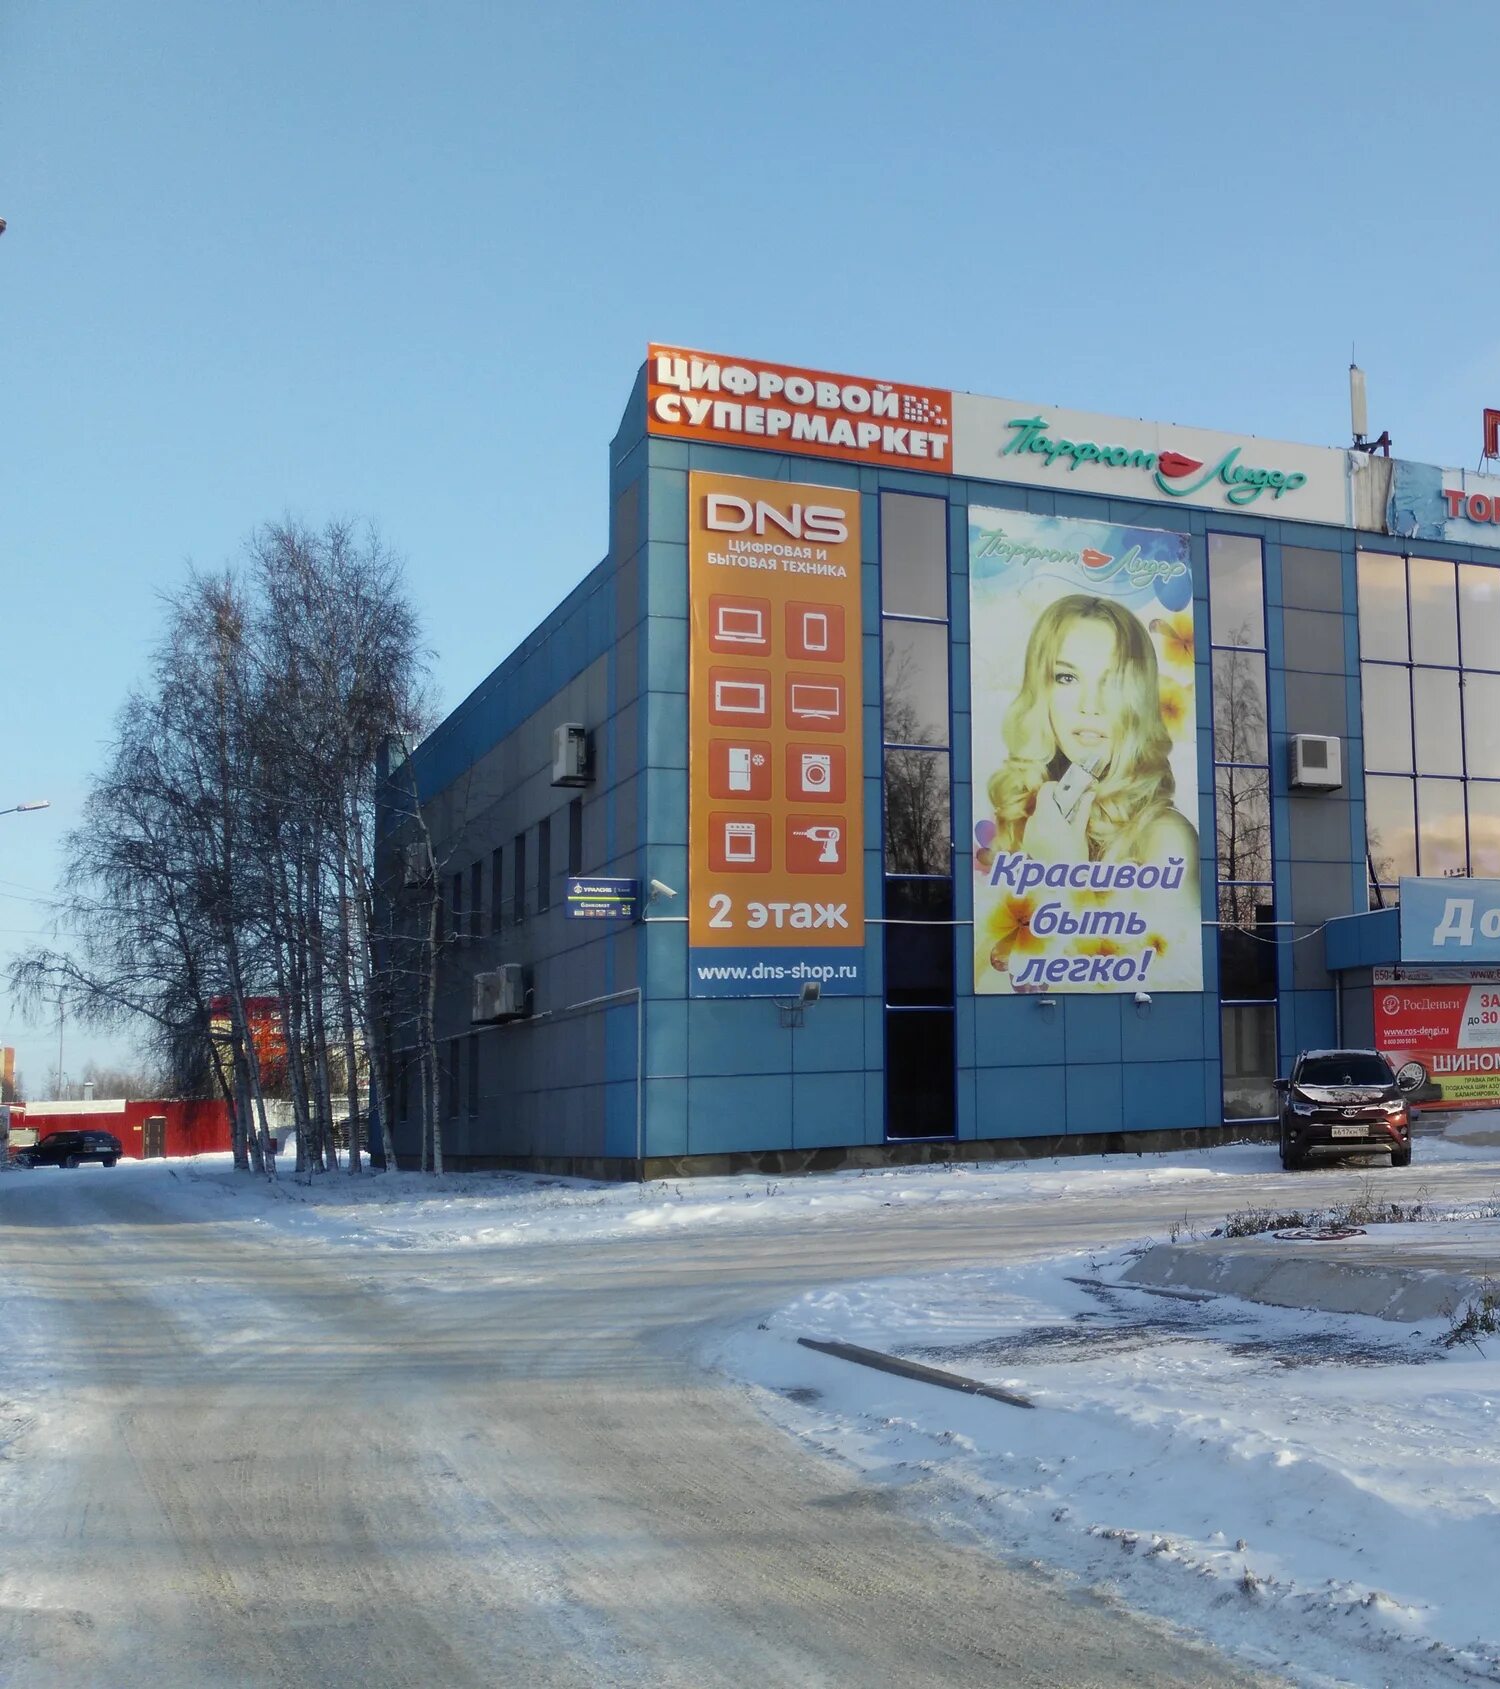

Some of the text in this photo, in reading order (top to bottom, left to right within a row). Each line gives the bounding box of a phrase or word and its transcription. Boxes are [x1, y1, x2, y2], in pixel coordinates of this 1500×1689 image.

[656, 354, 899, 418] ЦИФРОВОЙ
[655, 394, 949, 460] СУПЕРМАРКЕТ
[1000, 415, 1308, 505] Парфюм Лидер
[705, 494, 849, 543] DNS
[707, 552, 847, 578] БЫТОВАЯ ТЕХНИКА
[728, 539, 827, 560] ЦИФРОВАЯ И
[976, 528, 1187, 588] Парфюм Лидер
[990, 854, 1185, 895] Красивой
[709, 894, 849, 929] 2 этаж
[1033, 902, 1147, 935] быть
[698, 962, 857, 982] www.dns-shop.ru
[1016, 950, 1153, 983] легко!
[1403, 999, 1460, 1010] РосДеньги
[1481, 1011, 1498, 1024] 30
